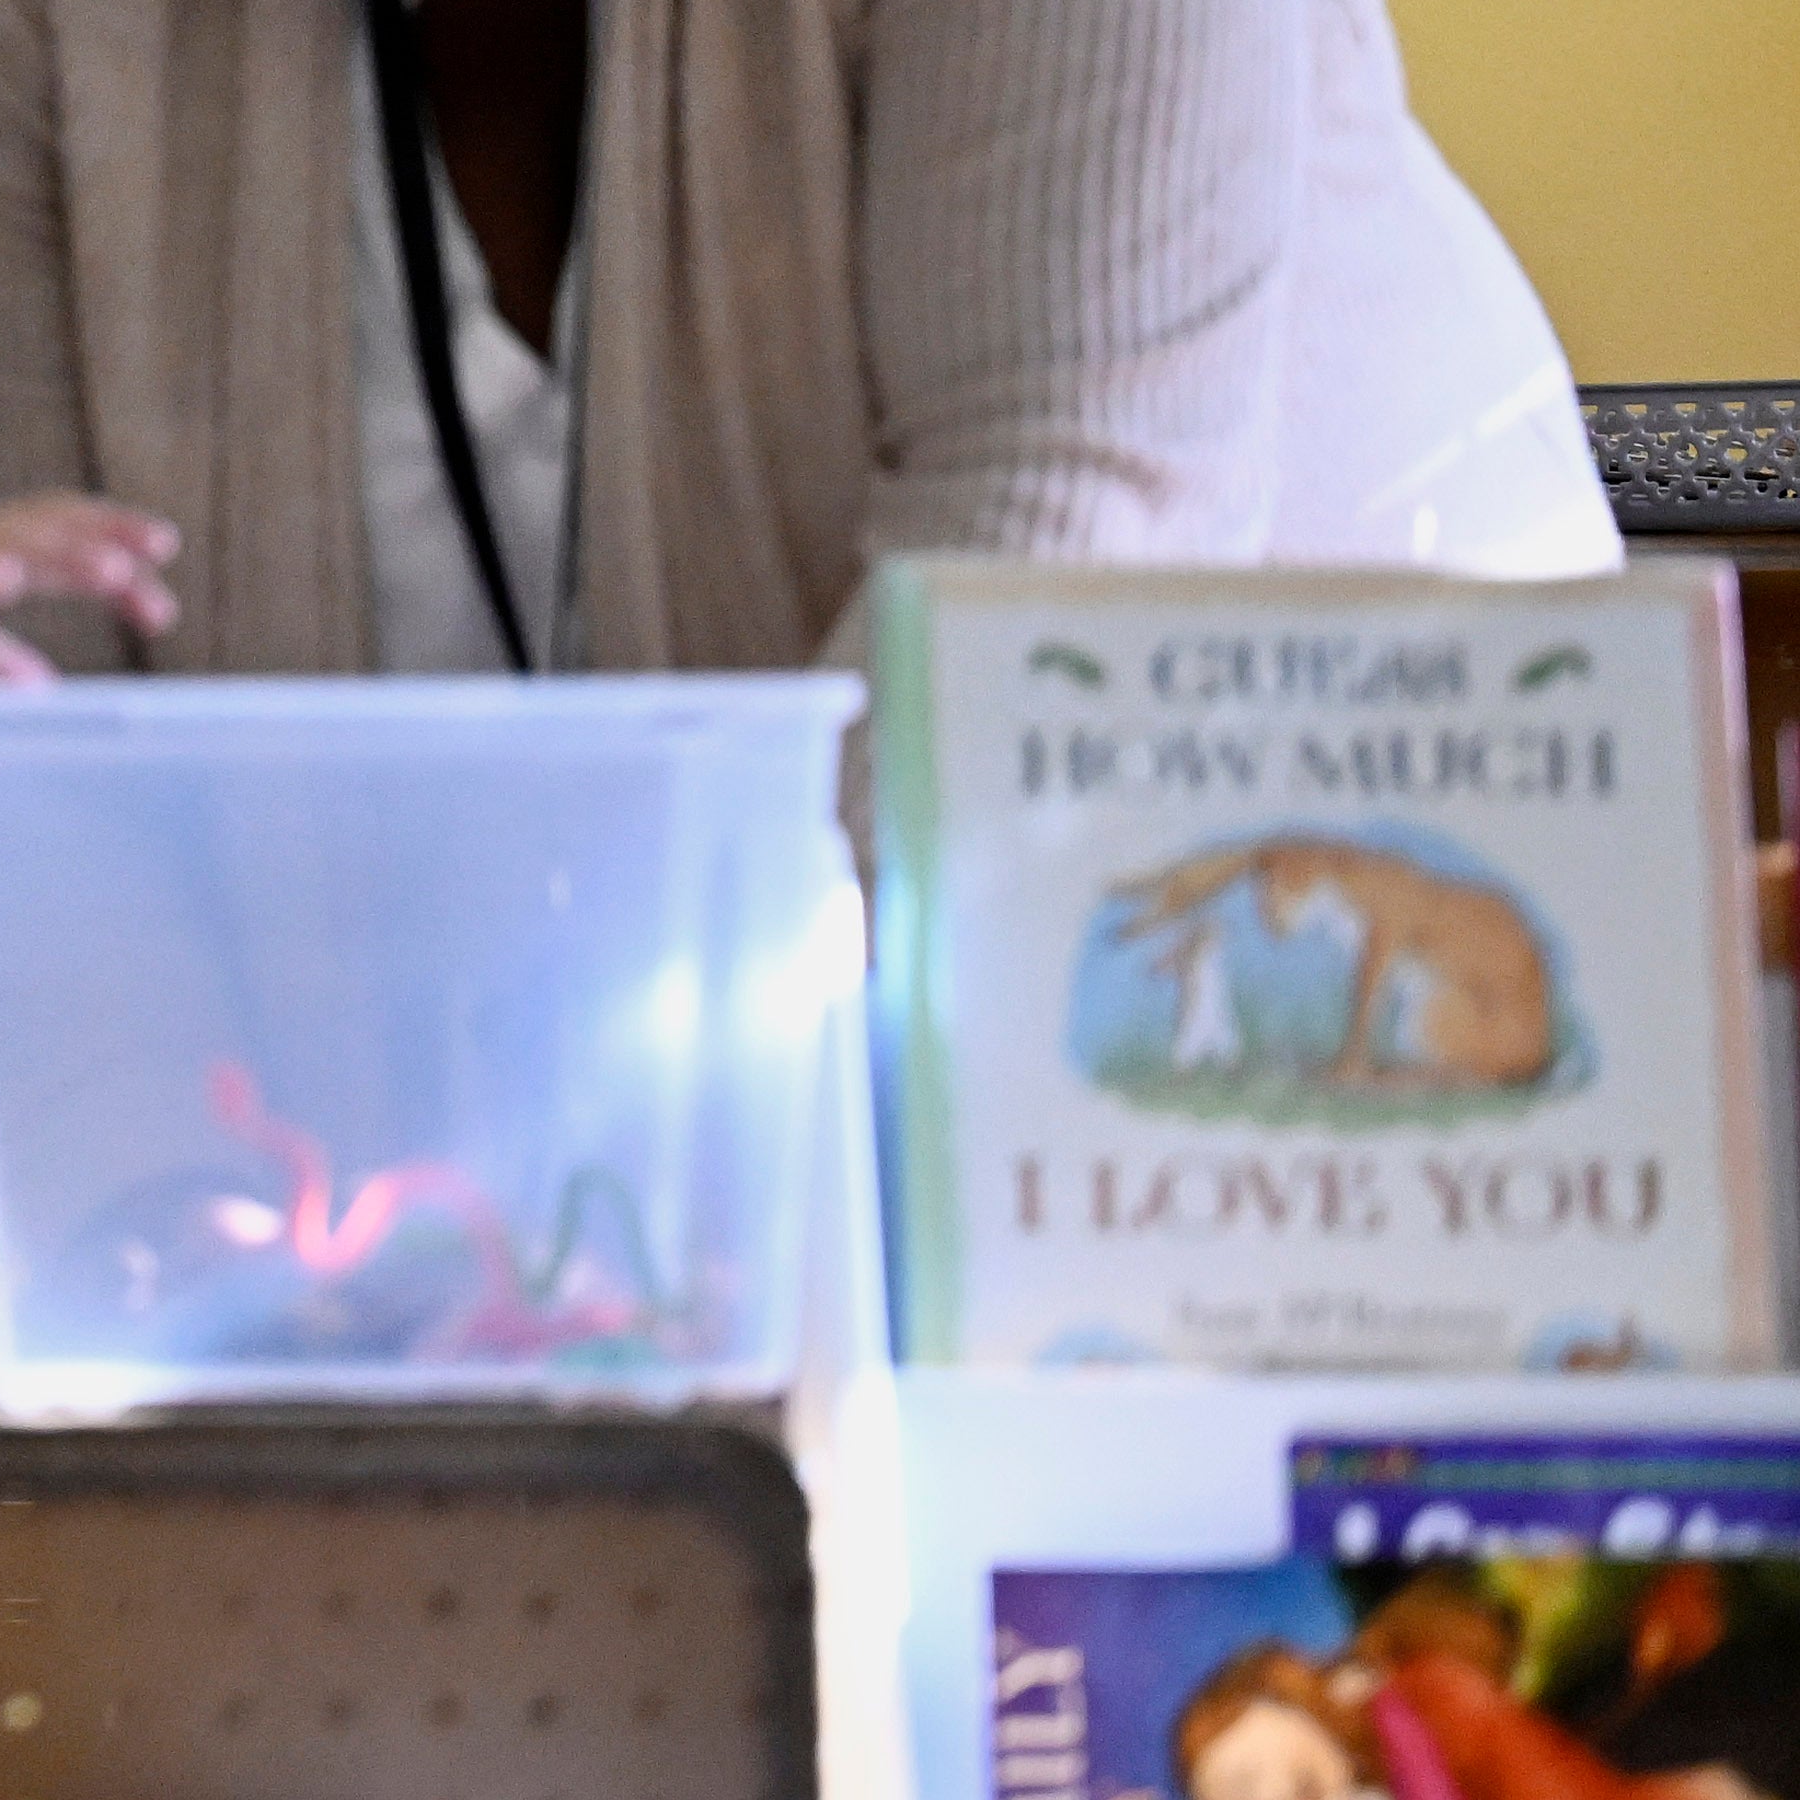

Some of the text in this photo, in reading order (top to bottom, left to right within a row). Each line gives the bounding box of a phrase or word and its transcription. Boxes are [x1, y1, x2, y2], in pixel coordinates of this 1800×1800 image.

[1297, 722, 1619, 800] MUCH
[1088, 1150, 1387, 1237] LOVE
[1420, 1150, 1666, 1240] YOU
